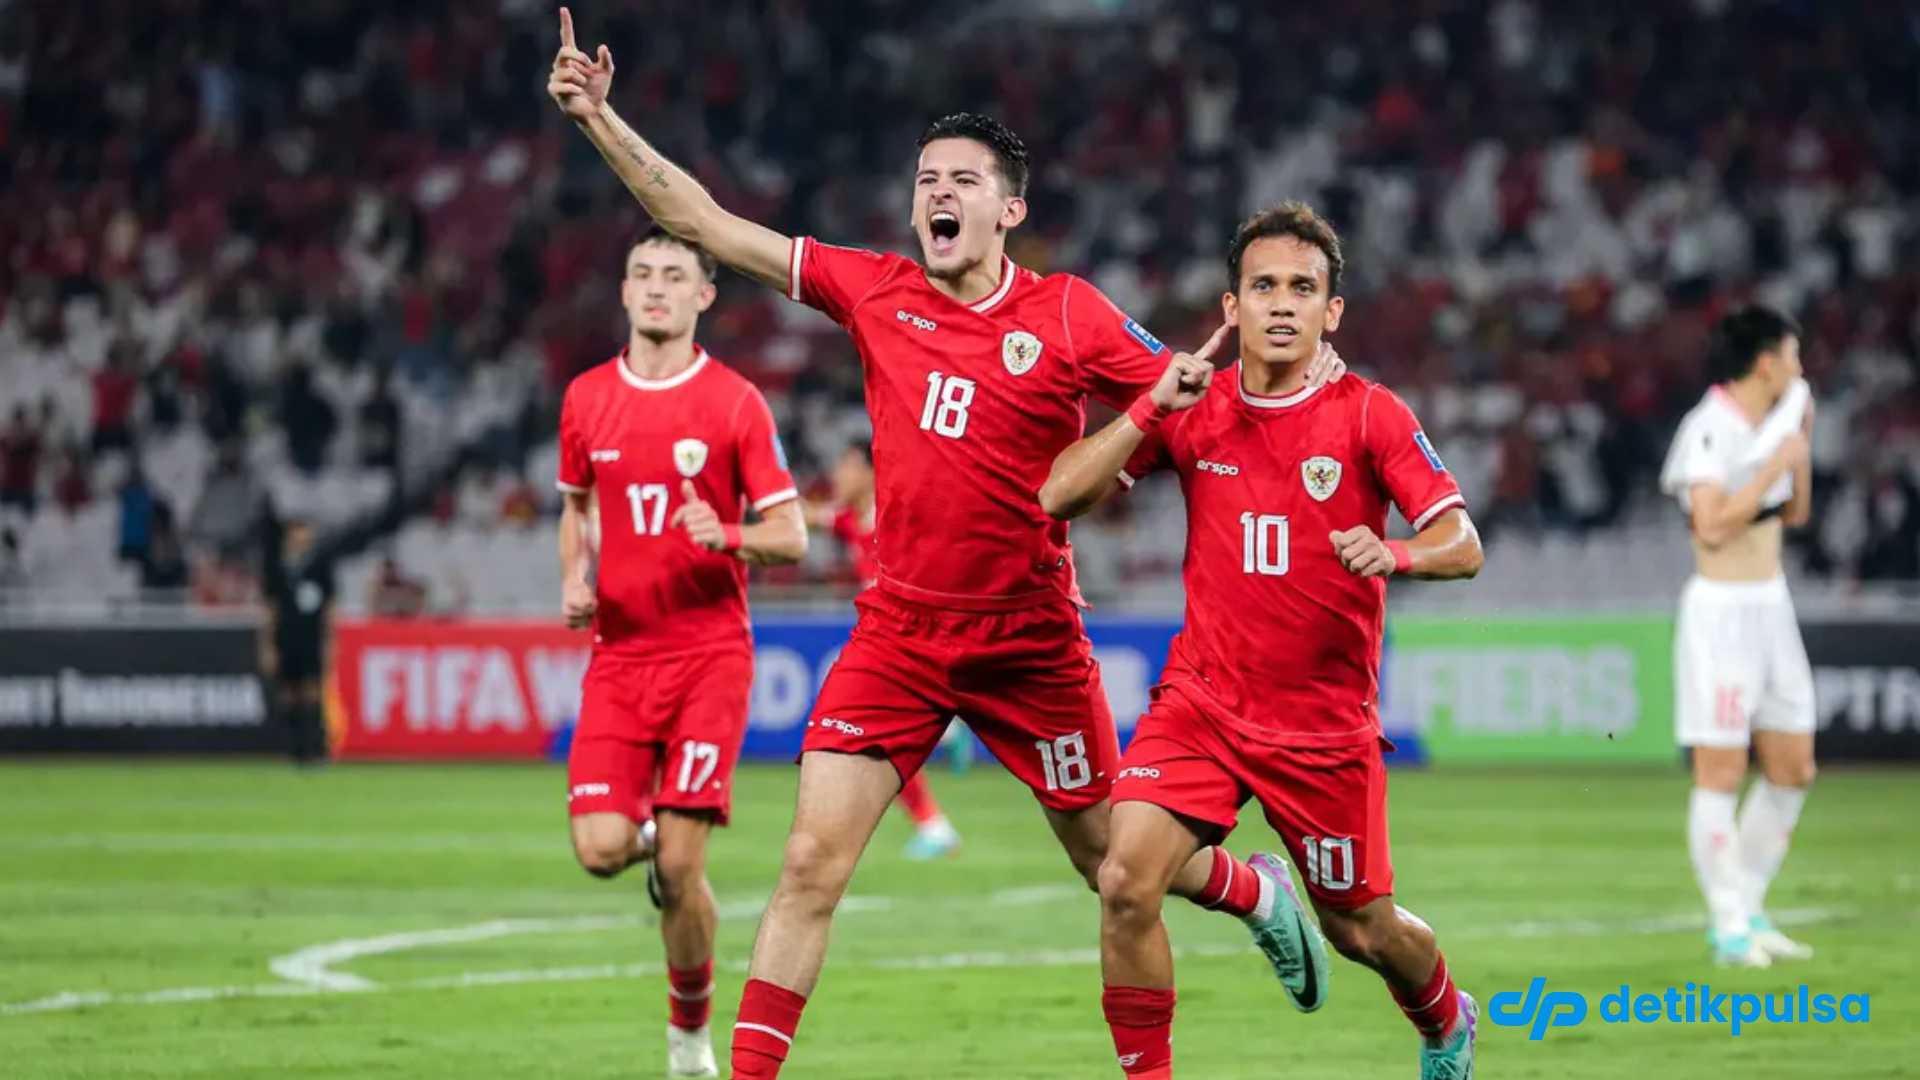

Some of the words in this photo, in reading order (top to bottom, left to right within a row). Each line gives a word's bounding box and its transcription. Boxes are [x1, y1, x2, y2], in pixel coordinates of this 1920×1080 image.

[896, 309, 937, 331] erspo
[920, 371, 976, 439] 18
[1197, 459, 1239, 475] erspo
[626, 483, 669, 536] 17
[1240, 511, 1289, 576] 10
[362, 645, 528, 732] FIFA
[821, 717, 865, 736] erspo
[677, 739, 720, 793] 17
[1034, 731, 1091, 792] 18
[1118, 766, 1161, 779] erspo
[1302, 836, 1354, 890] 10
